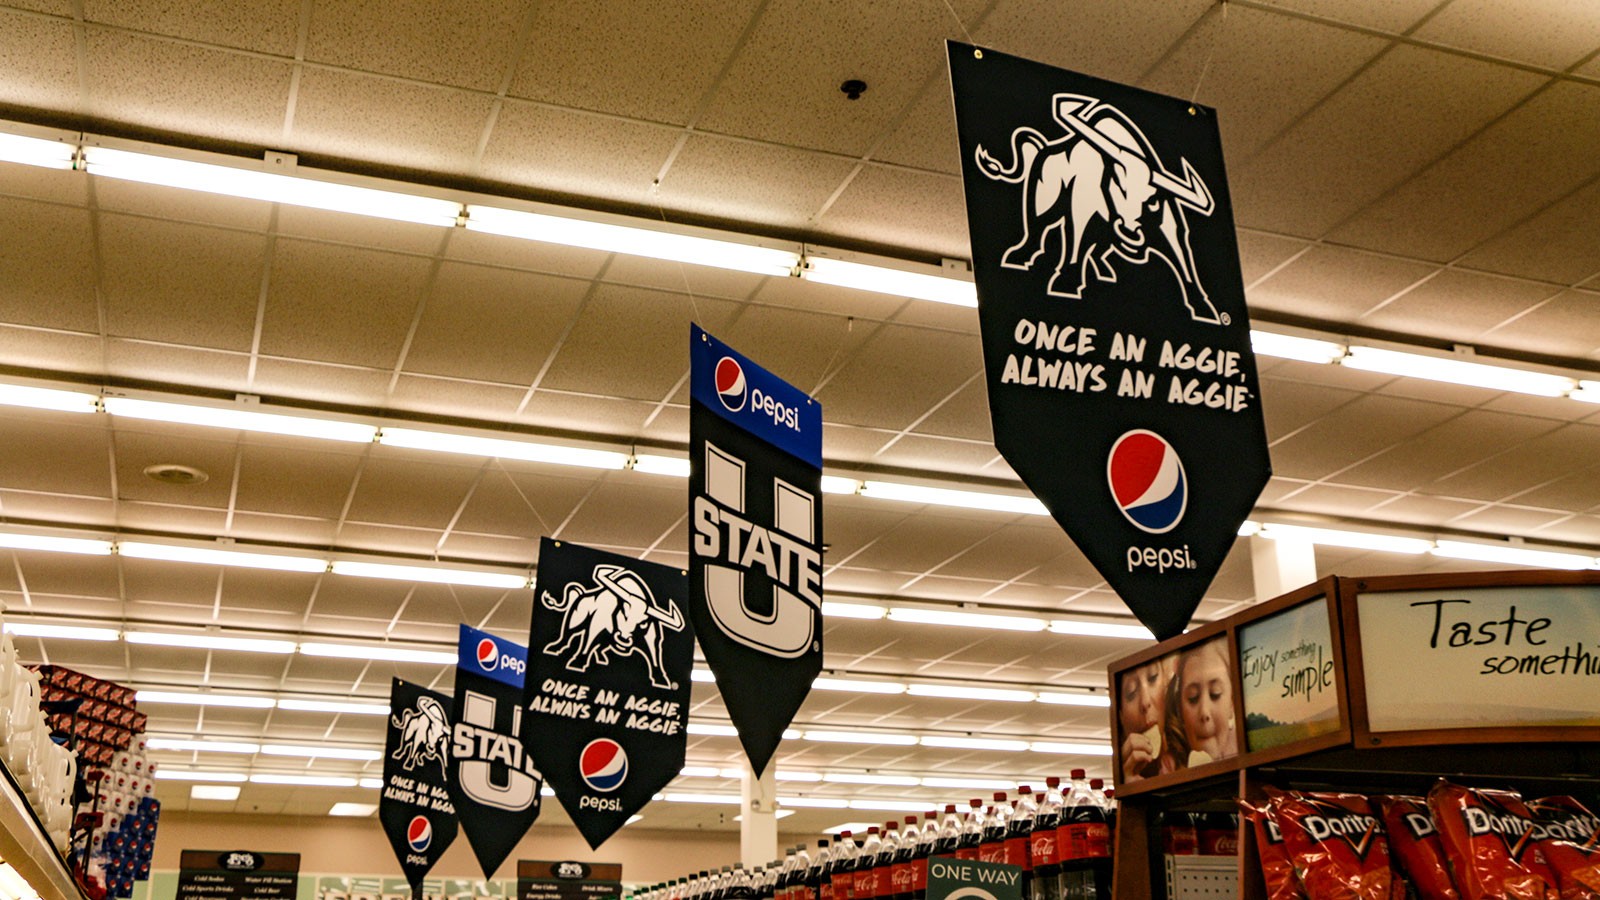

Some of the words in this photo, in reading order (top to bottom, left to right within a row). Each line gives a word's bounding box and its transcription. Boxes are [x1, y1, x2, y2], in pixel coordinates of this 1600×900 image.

[1014, 318, 1097, 355] ONCE
[1109, 332, 1147, 363] AN
[1158, 340, 1246, 382] AGGIE,
[1001, 353, 1107, 393] ALWAYS
[1117, 368, 1155, 399] AN
[1167, 375, 1249, 412] AGGIE
[751, 388, 799, 431] pepsi
[694, 495, 821, 609] STATE
[1127, 544, 1191, 574] pepsi
[1410, 599, 1551, 649] Taste
[1243, 646, 1278, 688] Enjoy
[1281, 645, 1333, 702] simple
[529, 695, 591, 719] ALWAYS
[594, 708, 621, 725] AN
[541, 678, 590, 700] ONCE
[594, 689, 620, 706] AN
[624, 695, 681, 720] AGGIE,
[383, 786, 416, 803] ALWAYS
[416, 795, 430, 807] AN
[390, 774, 415, 790] ONCE
[416, 782, 429, 794] AN
[579, 795, 620, 812] pepsi
[931, 863, 972, 881] ONE
[977, 868, 1019, 886] WAY
